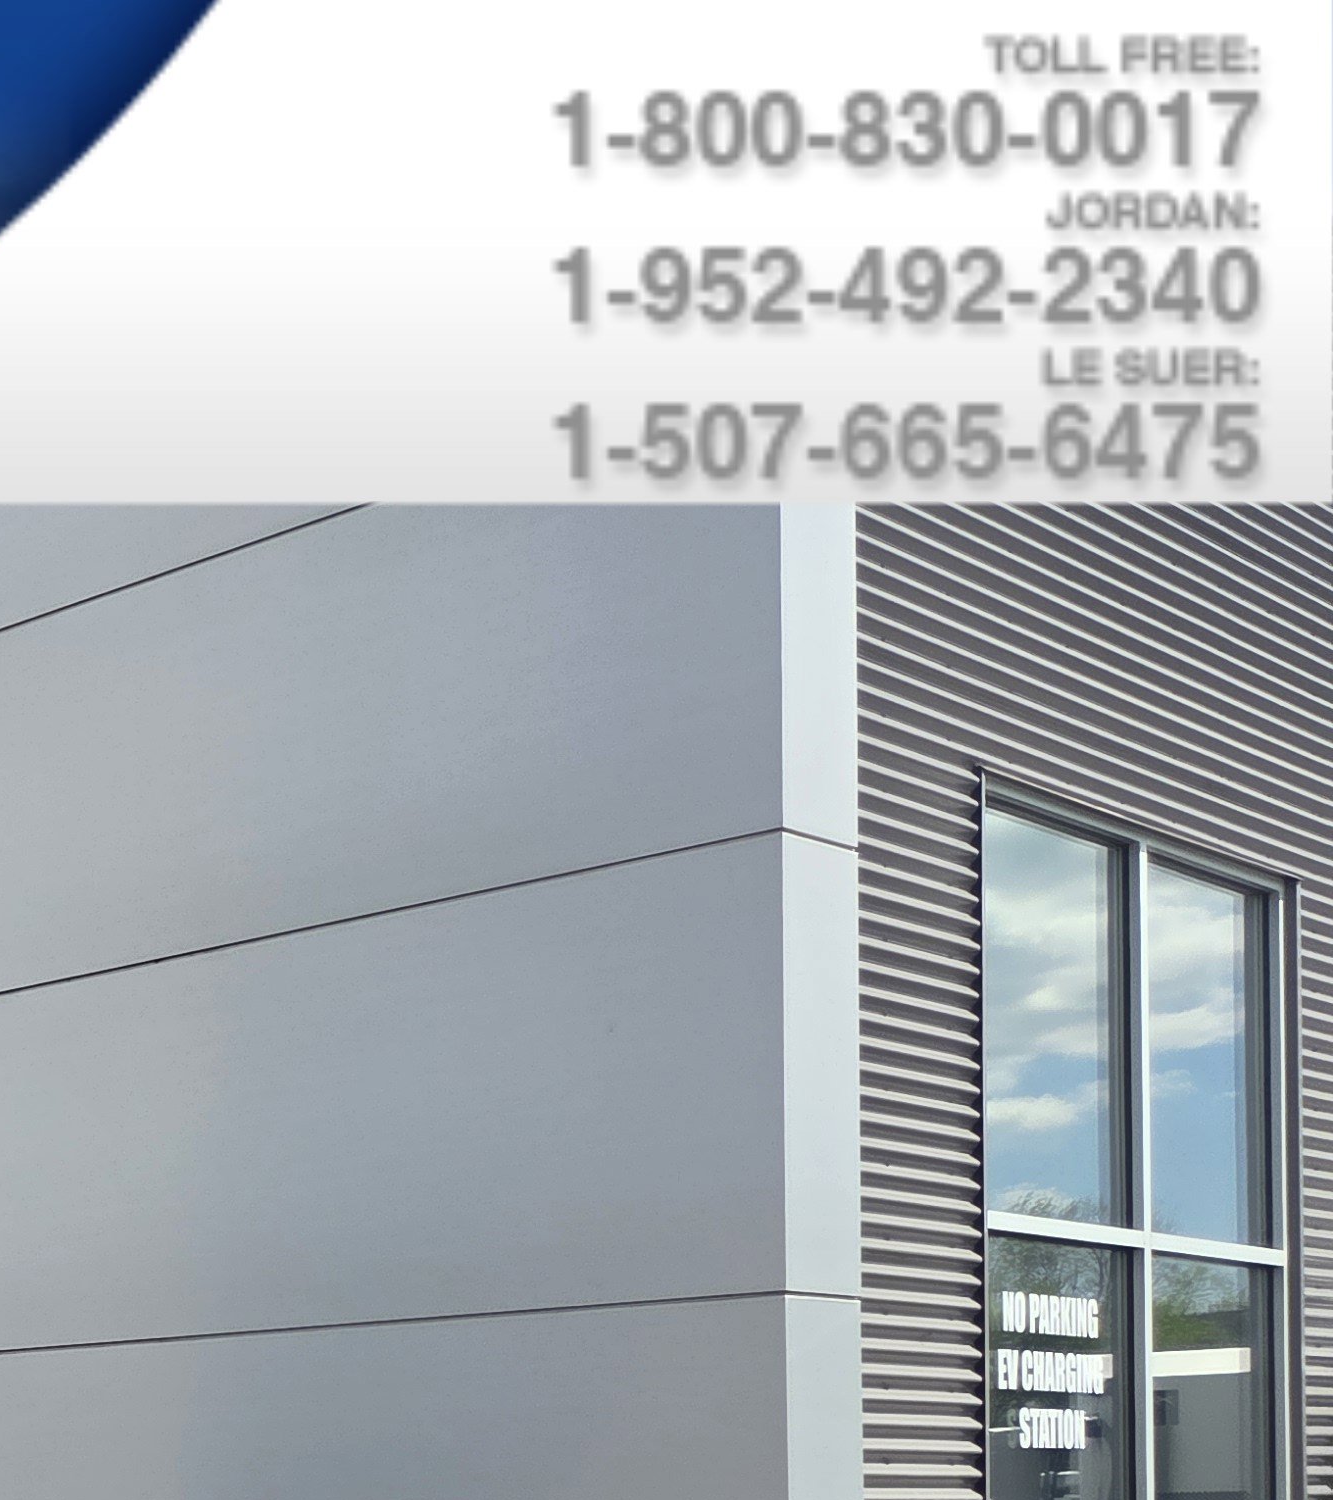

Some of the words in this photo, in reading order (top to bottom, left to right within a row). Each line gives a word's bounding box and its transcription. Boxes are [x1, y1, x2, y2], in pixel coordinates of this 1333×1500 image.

[1002, 1290, 1026, 1333] NO
[1029, 1293, 1099, 1339] PARKING
[997, 1348, 1018, 1390] EV
[1021, 1350, 1105, 1395] CHARGING
[1018, 1407, 1086, 1450] STATION
